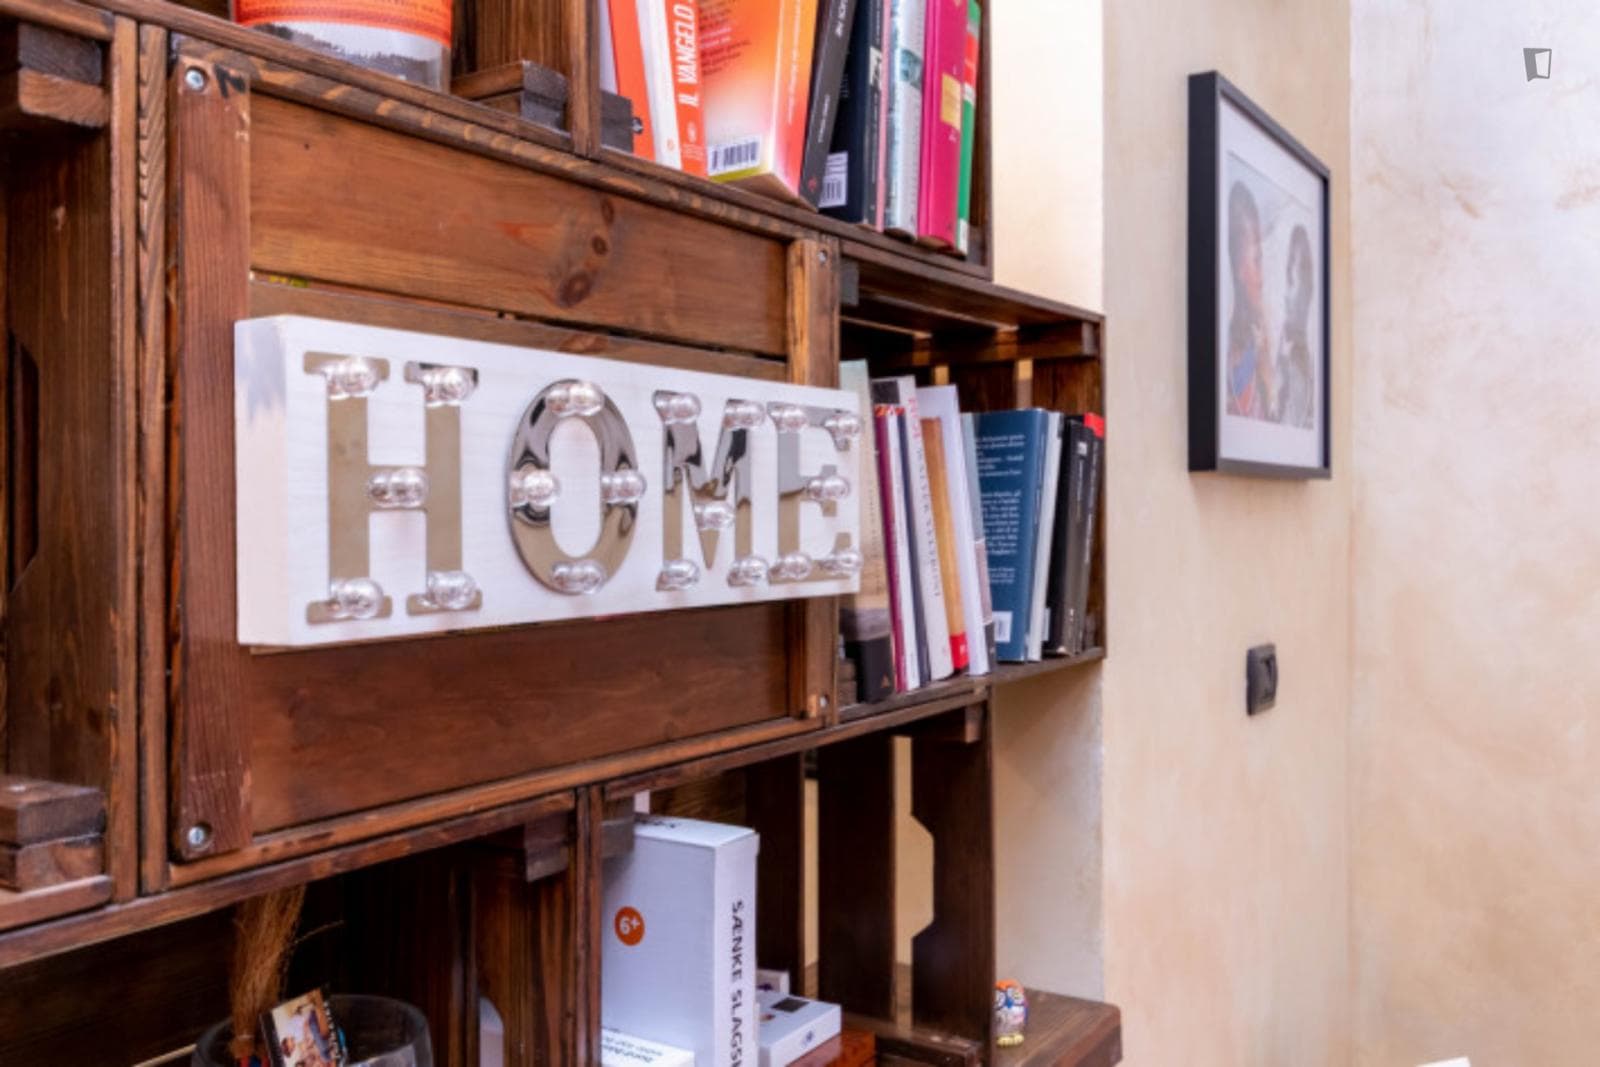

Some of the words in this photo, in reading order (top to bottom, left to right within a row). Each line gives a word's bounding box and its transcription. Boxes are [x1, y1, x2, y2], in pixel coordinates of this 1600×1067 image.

[673, 3, 699, 84] VANGELO
[678, 92, 700, 108] IL
[303, 350, 863, 624] HOME
